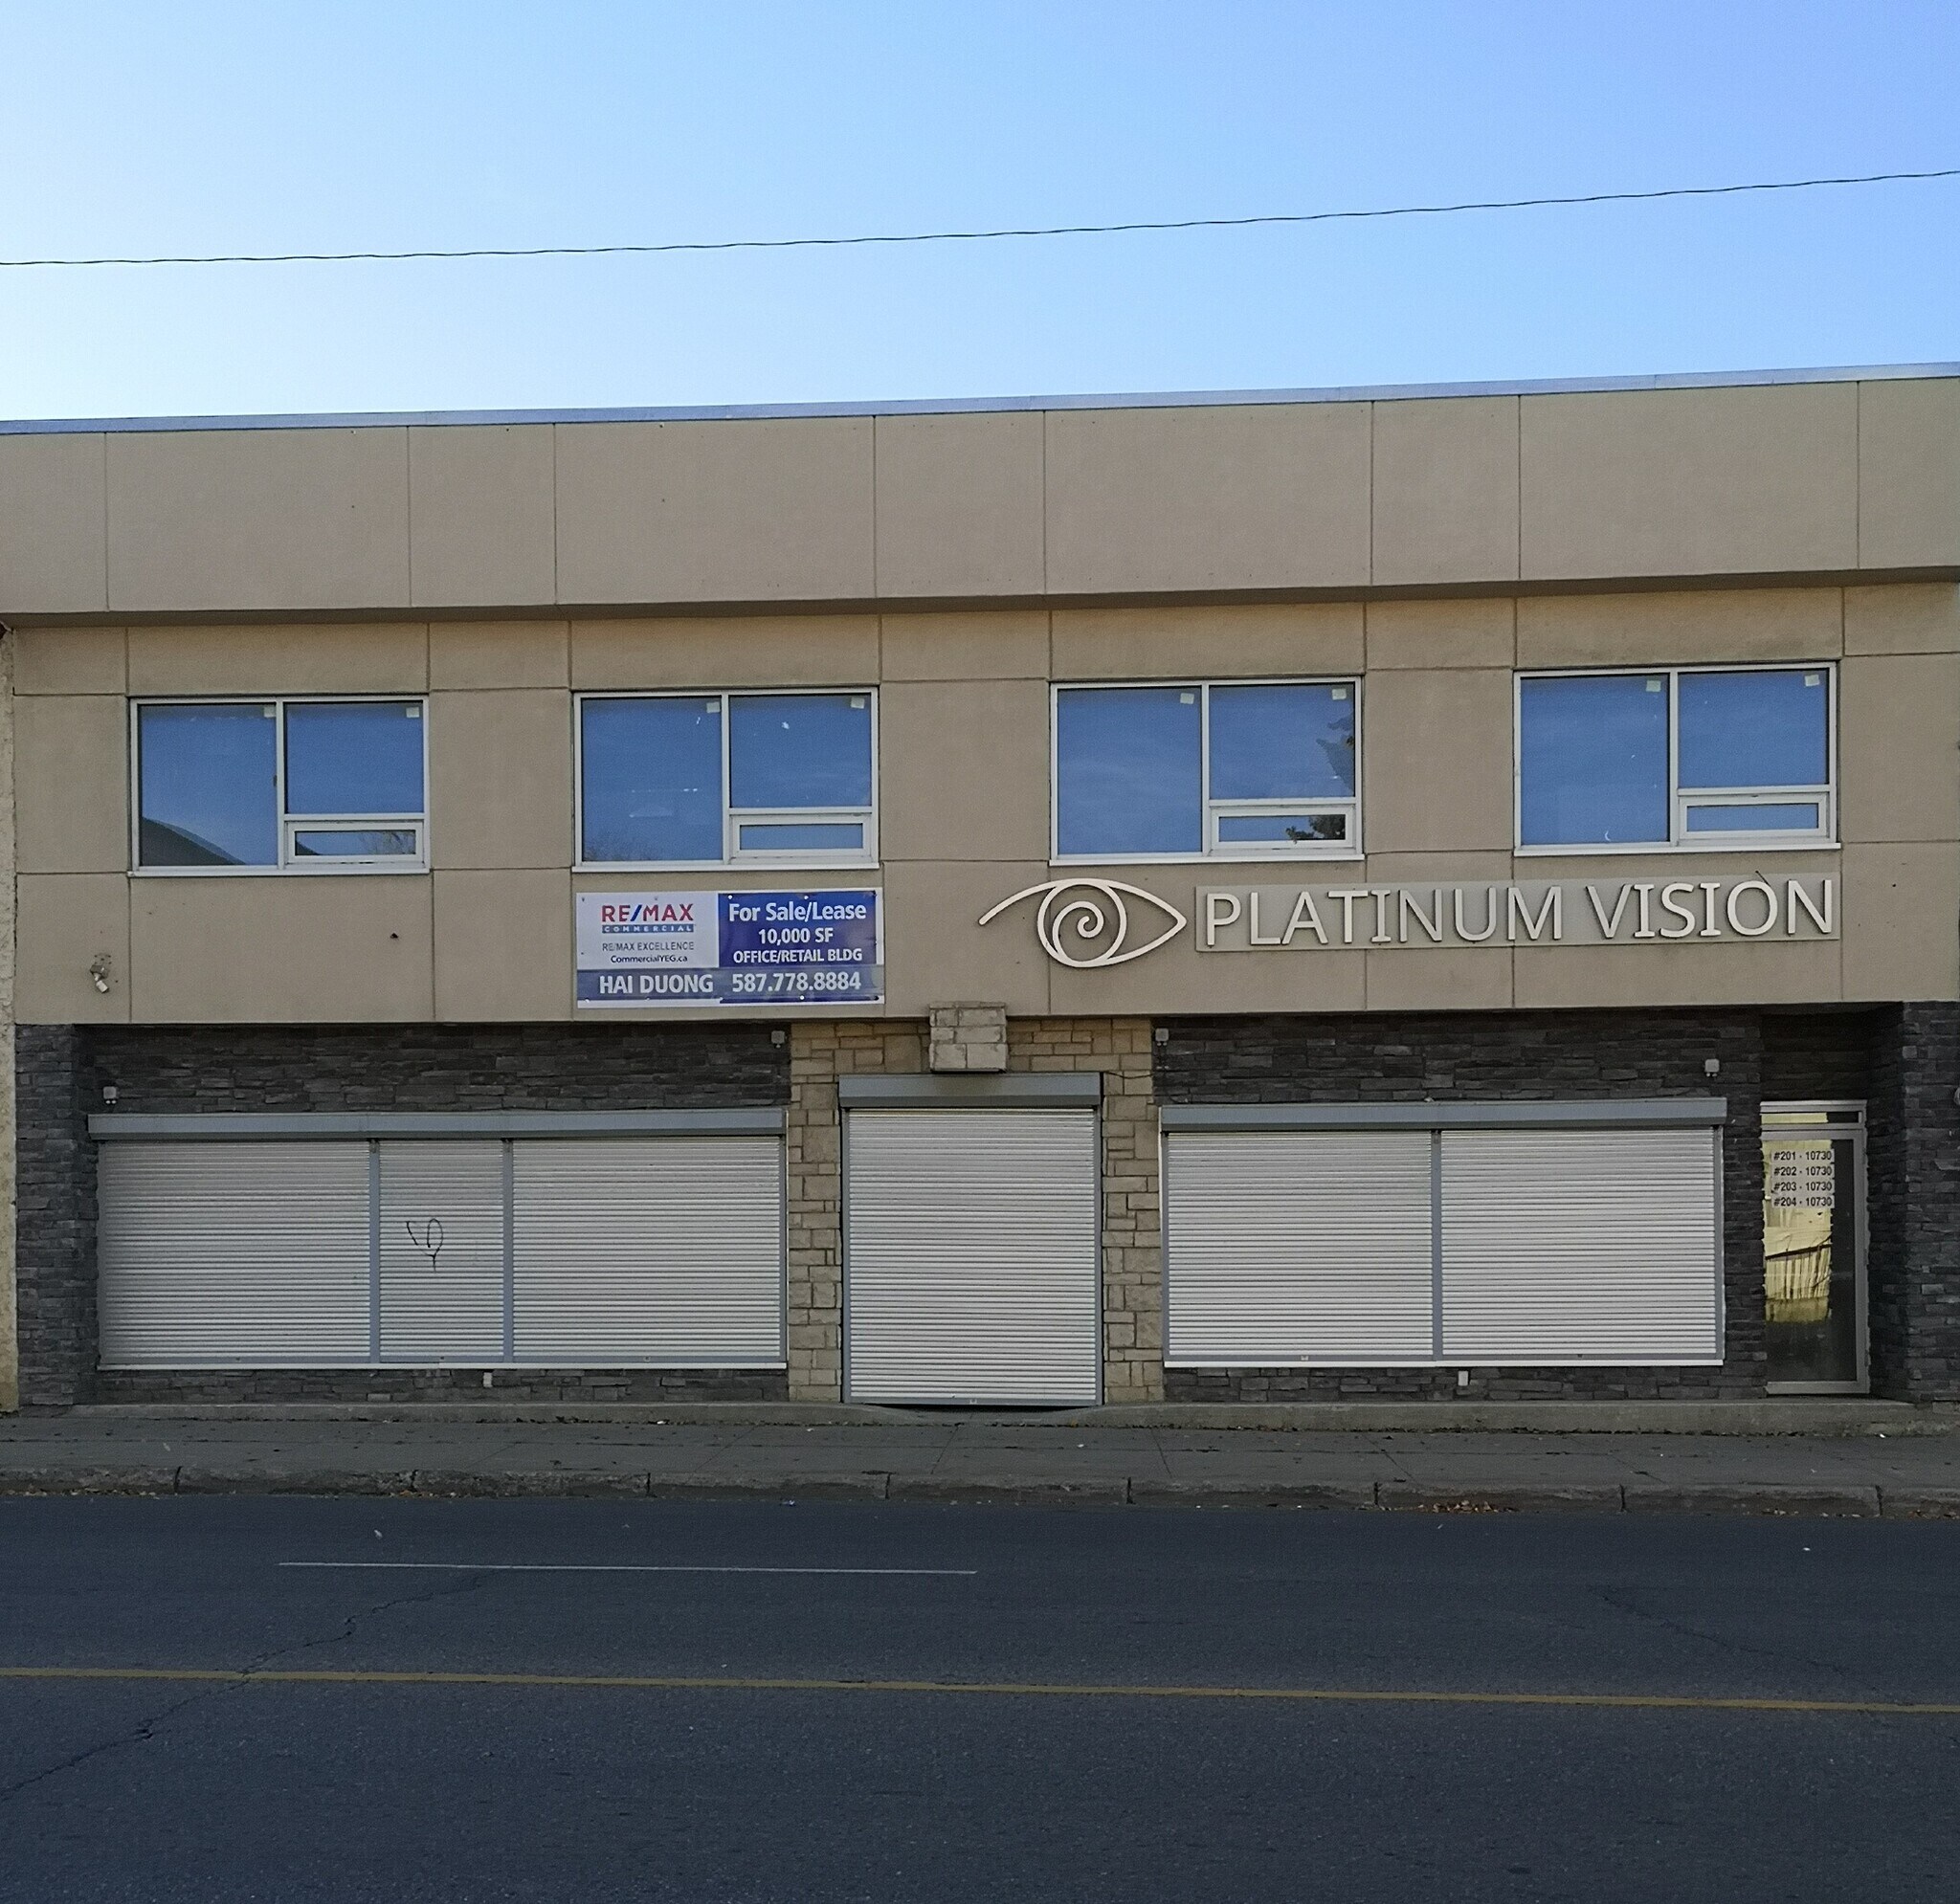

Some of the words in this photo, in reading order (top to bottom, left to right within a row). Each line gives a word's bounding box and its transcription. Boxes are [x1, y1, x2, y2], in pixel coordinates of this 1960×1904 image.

[601, 903, 694, 922] RE/MAX
[728, 903, 762, 921] For
[765, 901, 867, 922] Sale/Lease
[1205, 885, 1564, 947] PLATINUM
[1585, 879, 1836, 939] VISION
[603, 924, 694, 934] COMMERCIAL
[758, 928, 812, 945] 10,000
[814, 927, 835, 943] SF
[602, 941, 635, 952] RE/MAX
[637, 941, 695, 951] EXCELLENCE
[611, 955, 688, 963] CommercialYEG.ca
[733, 949, 825, 964] OFFICE/RETAIL
[827, 948, 863, 963] BLDG
[599, 975, 634, 994] HAI
[639, 974, 714, 993] DUONG
[731, 970, 862, 992] 587.778.8884
[1773, 1151, 1796, 1161] #201
[1805, 1151, 1832, 1161] 10730
[1773, 1166, 1797, 1176] #202
[1805, 1166, 1832, 1176] 10730
[1773, 1182, 1797, 1191] #203
[1805, 1182, 1832, 1191] 10730
[1773, 1197, 1797, 1207] #204
[1805, 1197, 1832, 1207] 10730
